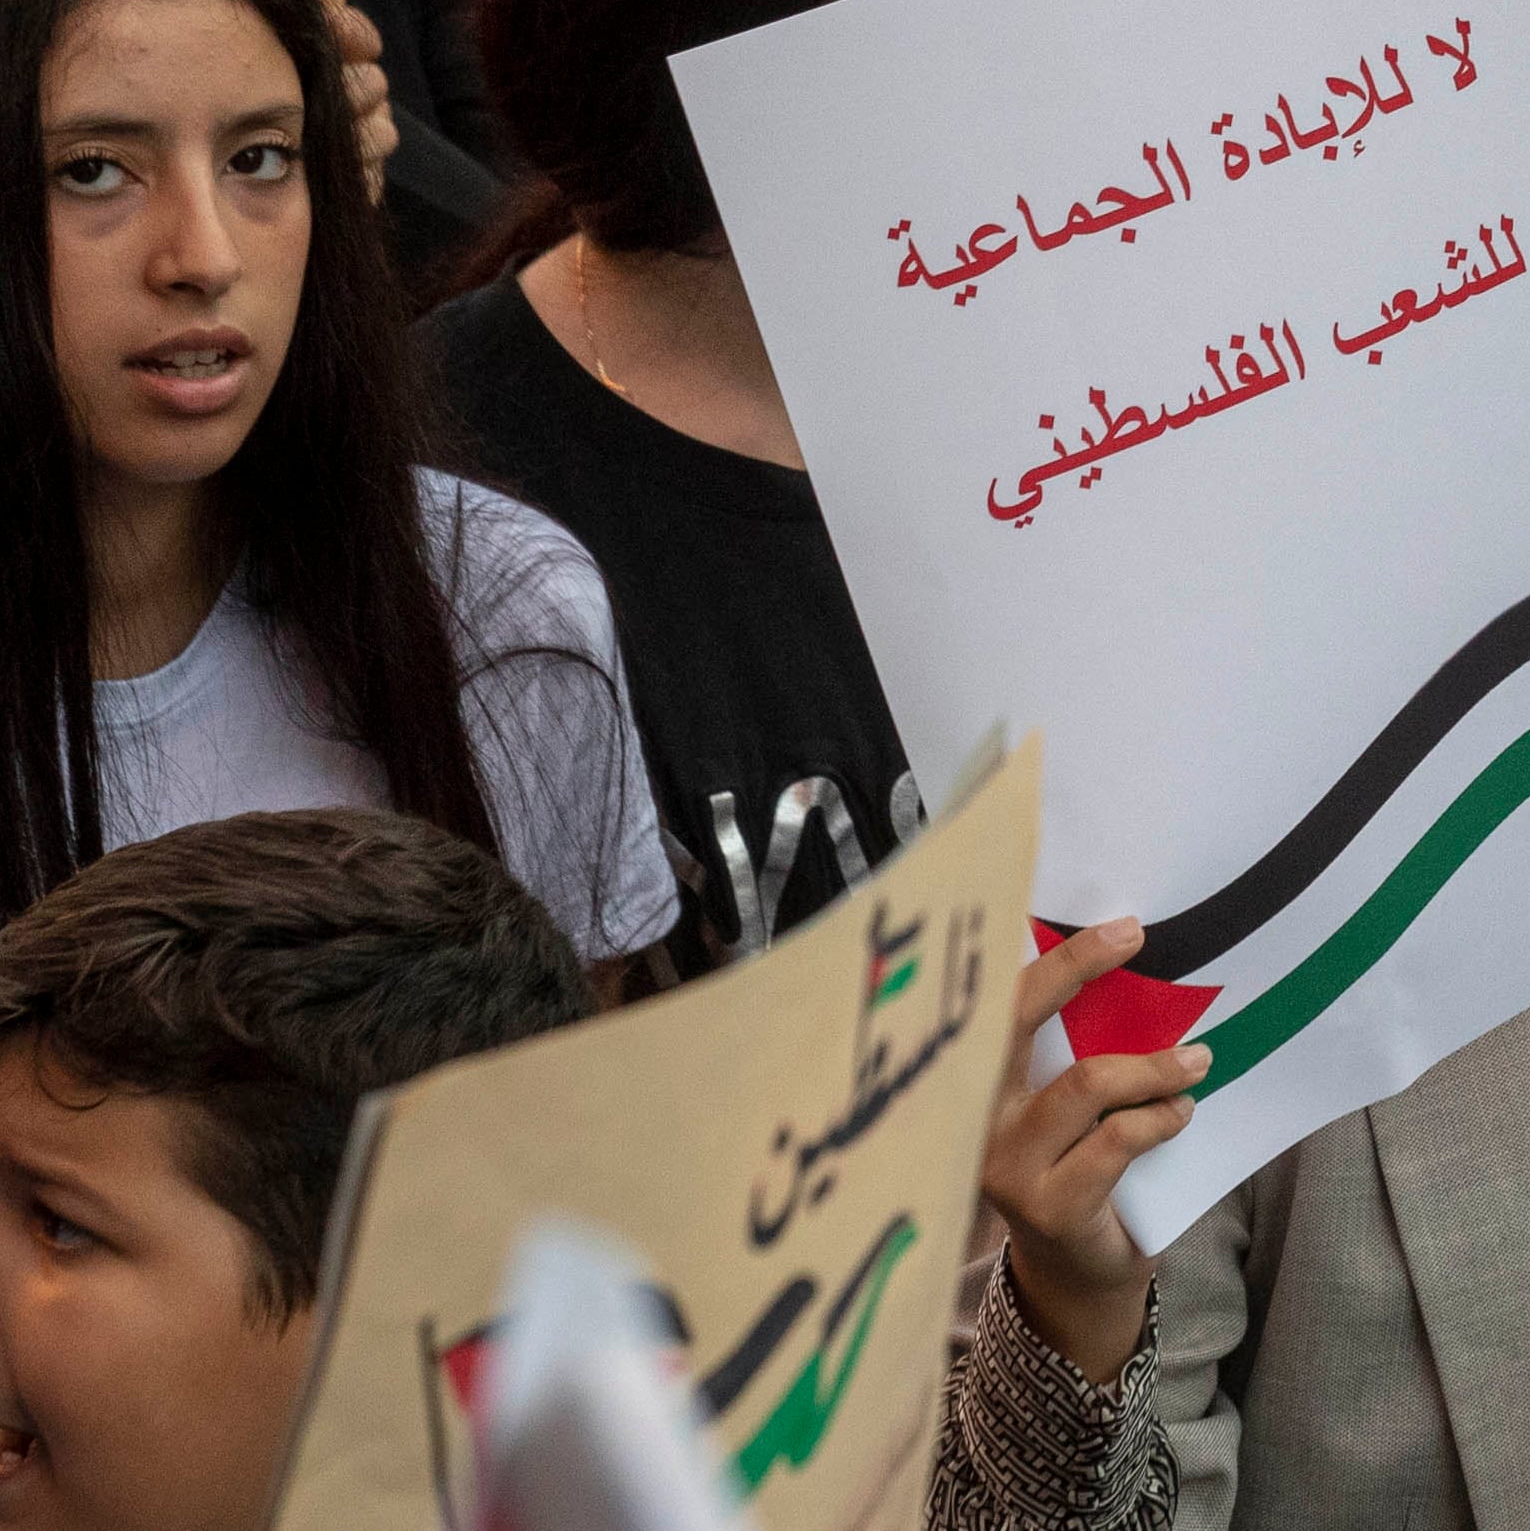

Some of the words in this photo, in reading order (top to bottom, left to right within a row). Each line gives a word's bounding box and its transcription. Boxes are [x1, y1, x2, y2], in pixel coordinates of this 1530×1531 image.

[1210, 46, 1414, 181] للإبادة
[1426, 19, 1478, 91] لا
[887, 139, 1192, 307] الجماعية
[1332, 215, 1527, 366] للشعب
[986, 318, 1307, 529] الفلسطيني
